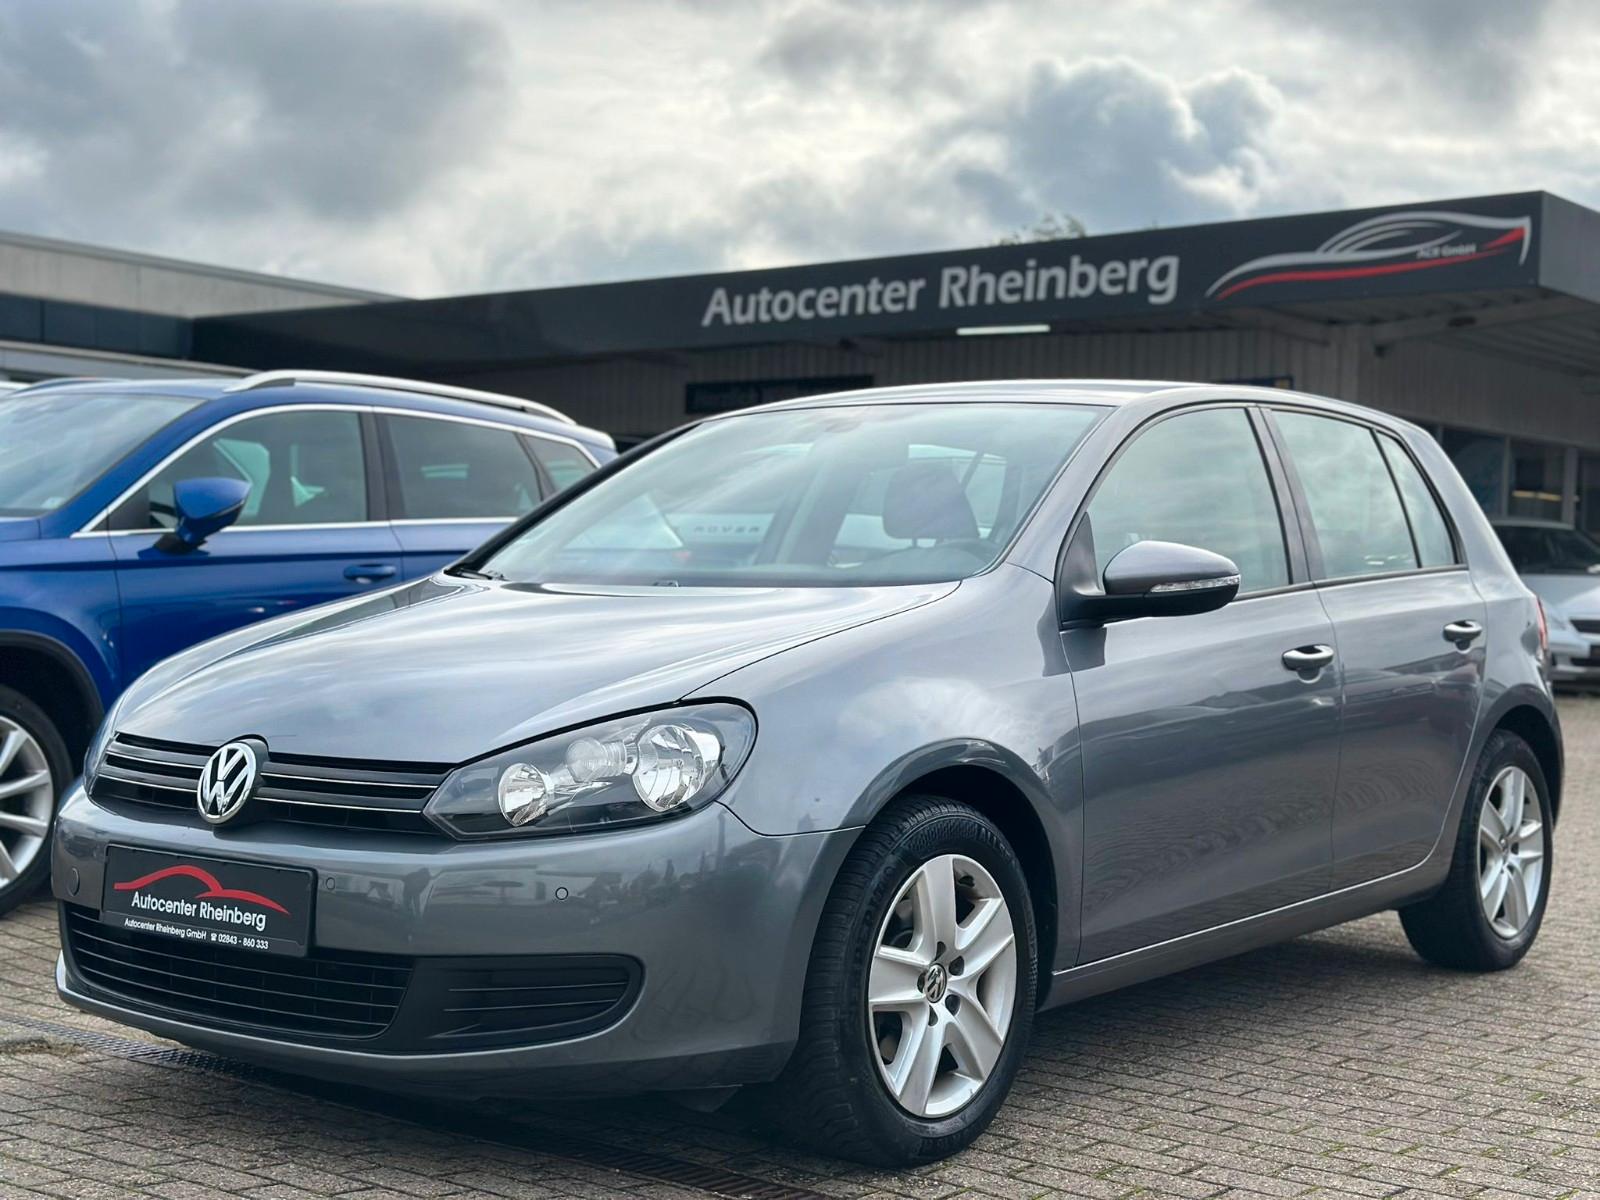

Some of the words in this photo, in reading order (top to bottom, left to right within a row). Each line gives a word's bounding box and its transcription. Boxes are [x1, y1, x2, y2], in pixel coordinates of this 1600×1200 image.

[701, 277, 926, 327] Autocenter
[938, 254, 1180, 308] Rheinberg
[131, 891, 198, 917] Autocenter
[199, 901, 266, 932] Rheinberg
[124, 918, 155, 931] Autocenter
[156, 923, 185, 938] Rheinberg
[186, 928, 207, 940] GmbH
[218, 933, 238, 945] 02843
[243, 937, 255, 948] 860
[256, 939, 269, 950] 333
